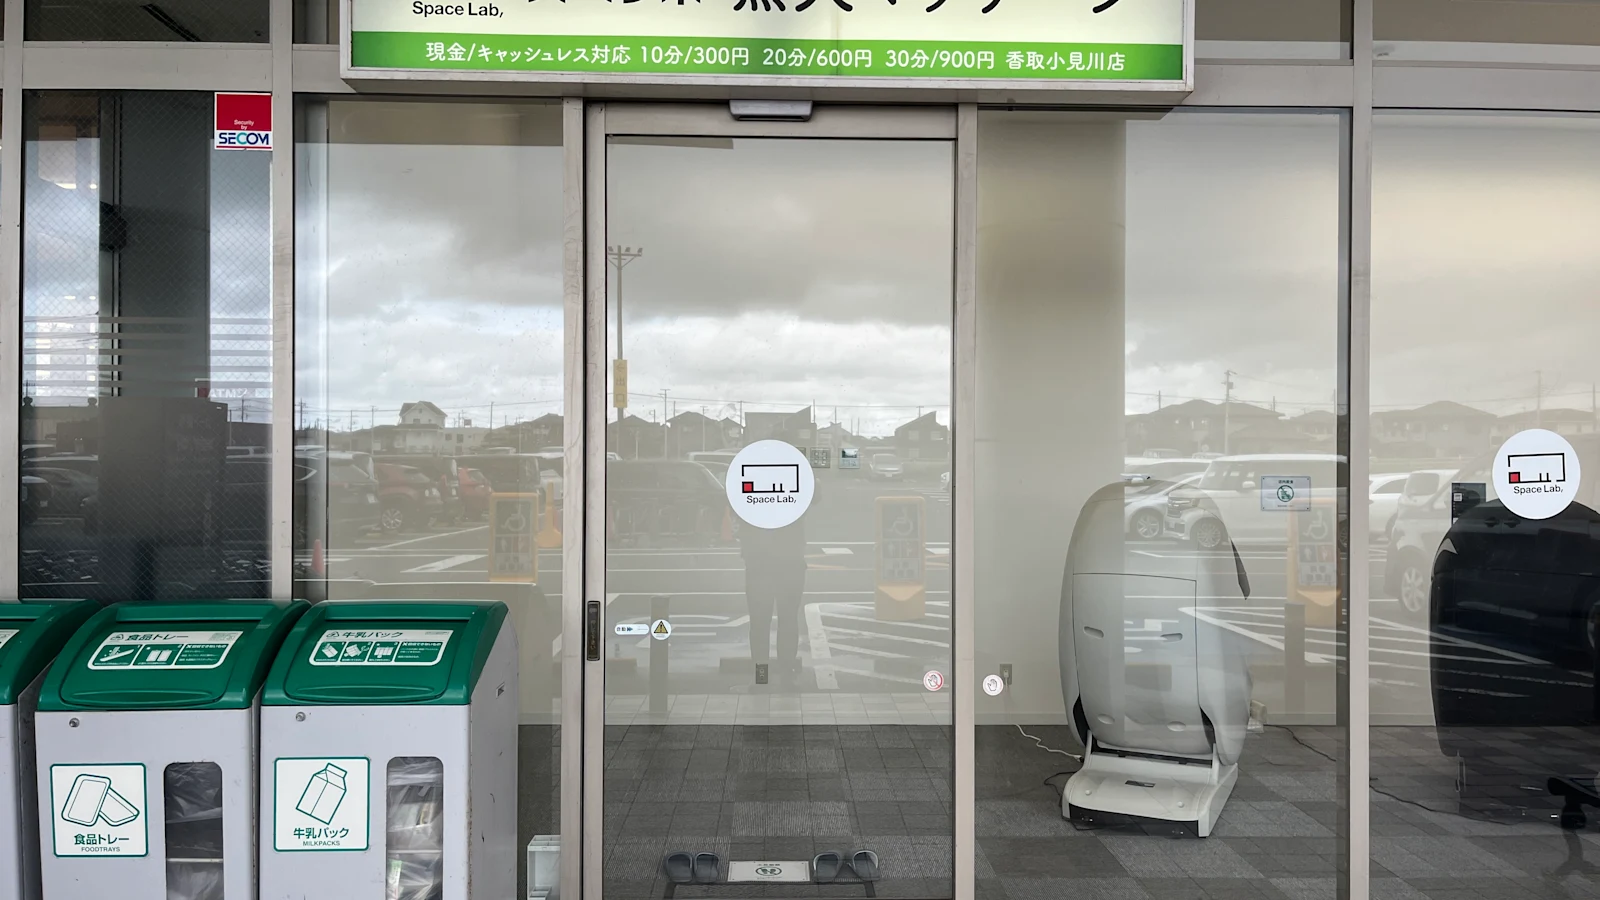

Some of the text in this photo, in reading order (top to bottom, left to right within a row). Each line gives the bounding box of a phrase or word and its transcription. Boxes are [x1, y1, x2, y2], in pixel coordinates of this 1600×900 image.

[412, 1, 504, 18] Space Lab,
[425, 41, 1126, 72] 現金/キャッシュレス対応 10分/300円 20分/600円 30分/900円 香取小見川店
[219, 132, 269, 145] SECOM
[1513, 486, 1542, 496] Space
[746, 495, 775, 504] Space
[125, 634, 189, 642] 食品トレー
[73, 833, 130, 845] 食品トレー
[293, 827, 349, 840] 牛乳パック
